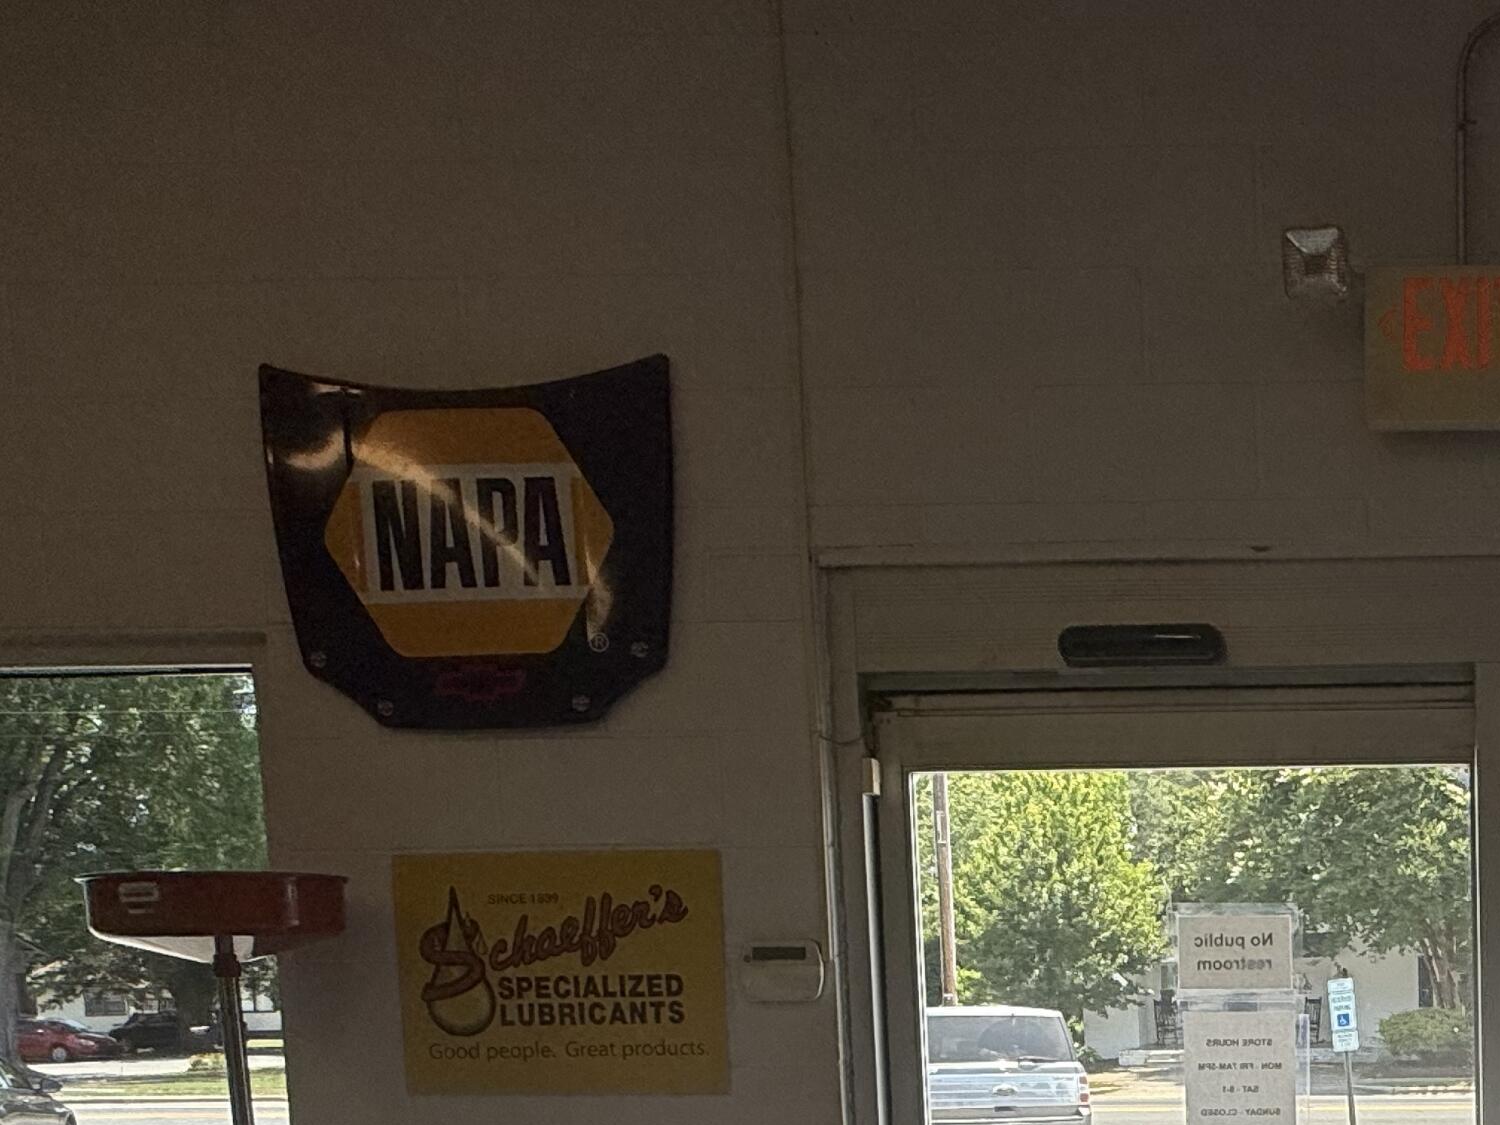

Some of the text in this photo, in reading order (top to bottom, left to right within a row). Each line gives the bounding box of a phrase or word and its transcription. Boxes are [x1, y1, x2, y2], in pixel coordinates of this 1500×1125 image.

[373, 476, 572, 592] NAPA
[487, 893, 527, 904] SINCE
[419, 884, 688, 1001] Schaeffer's
[498, 973, 685, 1000] SPECIALIZED
[499, 1000, 686, 1027] LUBRICANTS
[429, 1040, 710, 1062] Good people. Great products.
